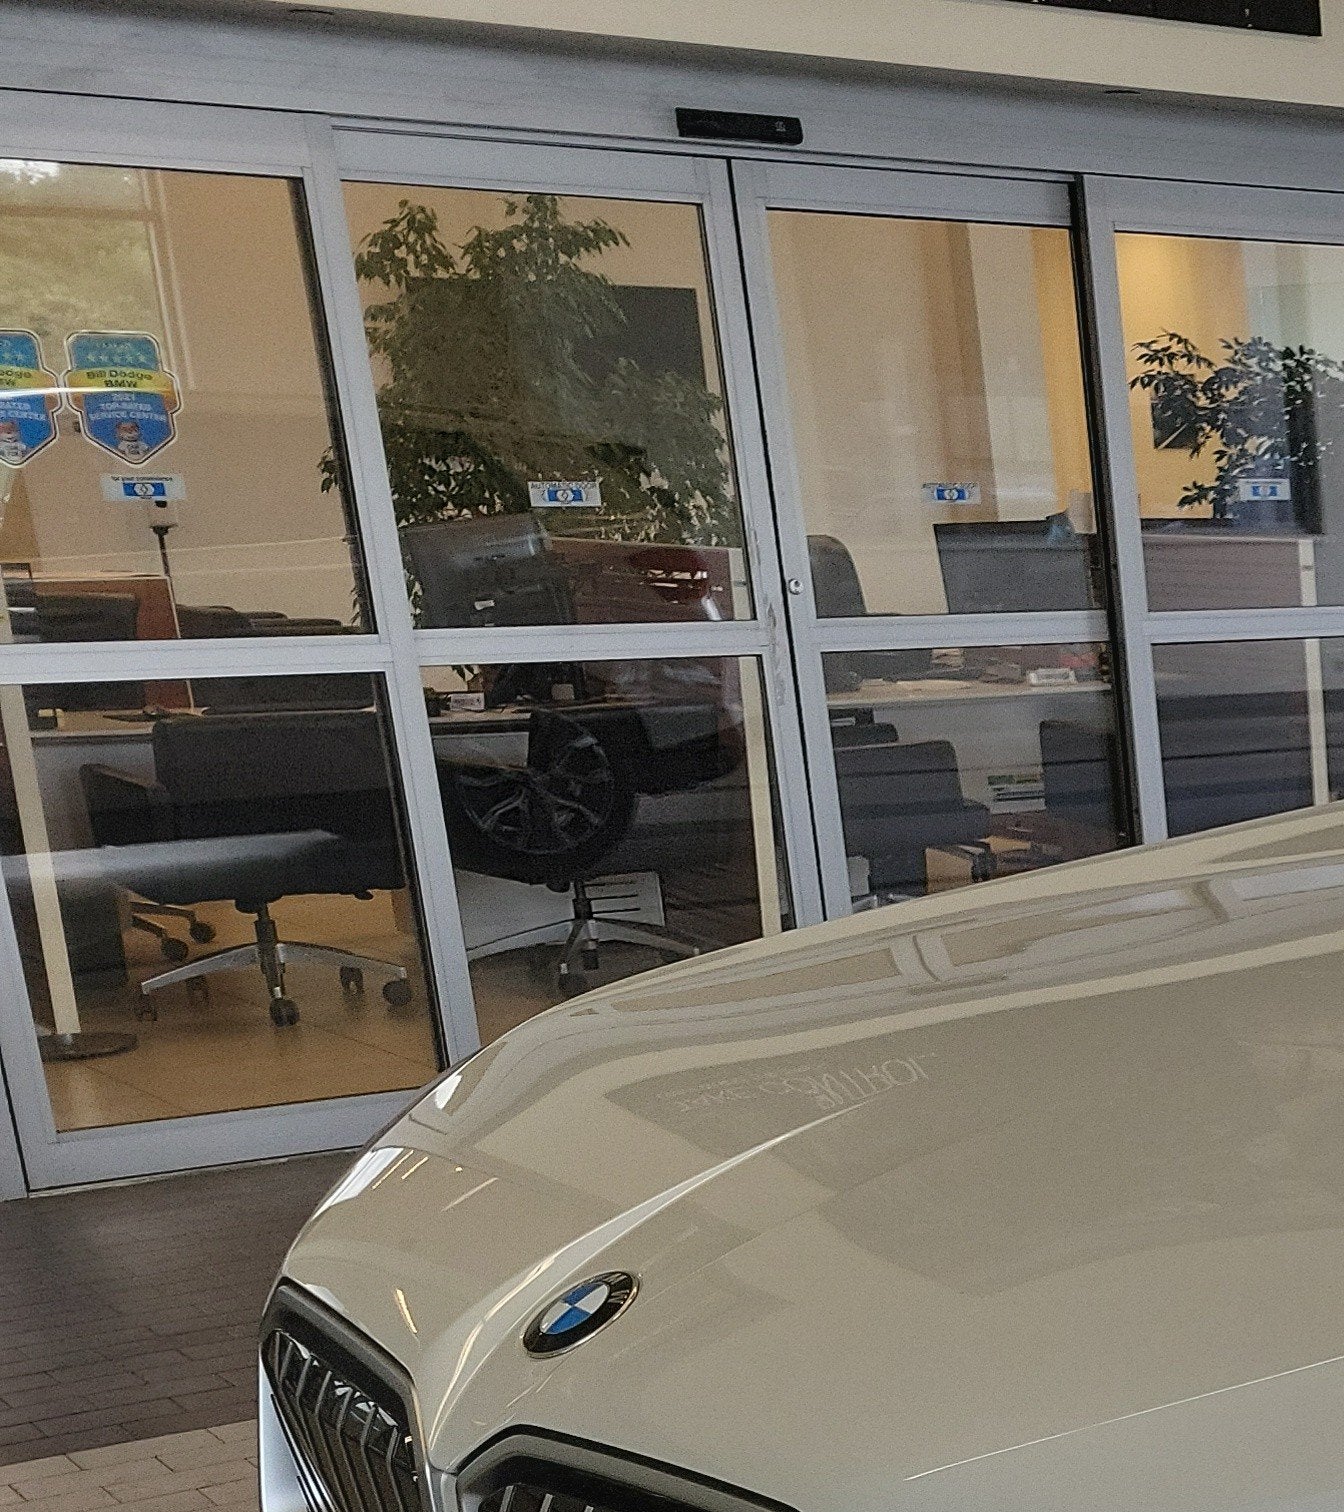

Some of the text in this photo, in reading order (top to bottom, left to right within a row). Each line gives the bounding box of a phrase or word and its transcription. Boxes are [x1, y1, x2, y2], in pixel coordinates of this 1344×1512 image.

[86, 369, 153, 381] Bill Dodge
[103, 379, 138, 388] BMW
